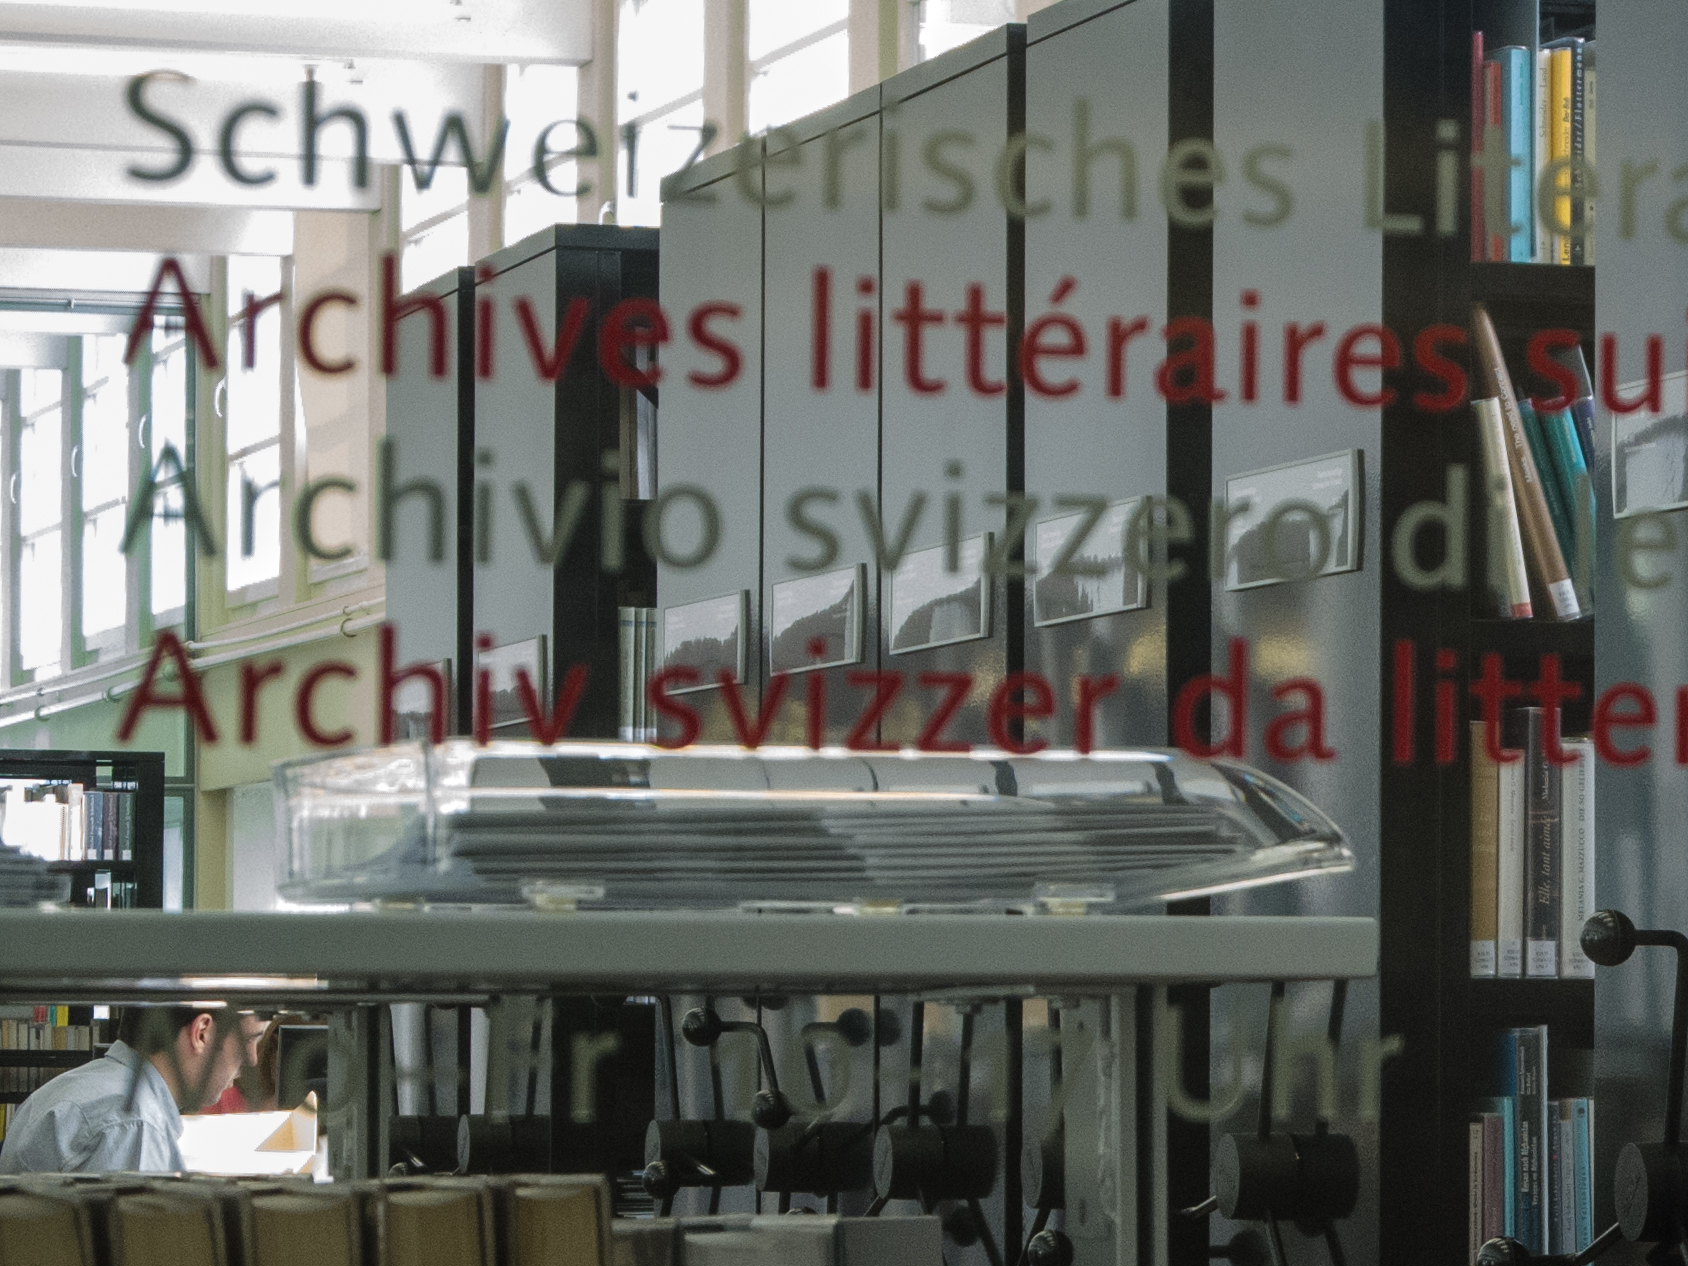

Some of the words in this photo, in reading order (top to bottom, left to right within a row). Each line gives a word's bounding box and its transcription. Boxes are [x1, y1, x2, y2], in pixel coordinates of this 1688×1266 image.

[124, 68, 1296, 228] Schweizerisches
[124, 250, 745, 389] Archives
[811, 266, 1469, 412] littéraires
[1511, 432, 1524, 450] The
[121, 436, 724, 572] Archivio
[783, 460, 1332, 583] svizzero
[1392, 463, 1510, 590] di
[116, 622, 588, 749] Archiv
[646, 636, 1121, 757] svizzer
[1172, 638, 1337, 761] da
[1576, 827, 1586, 873] MAZZUCCO
[1162, 1000, 1406, 1121] Uhr
